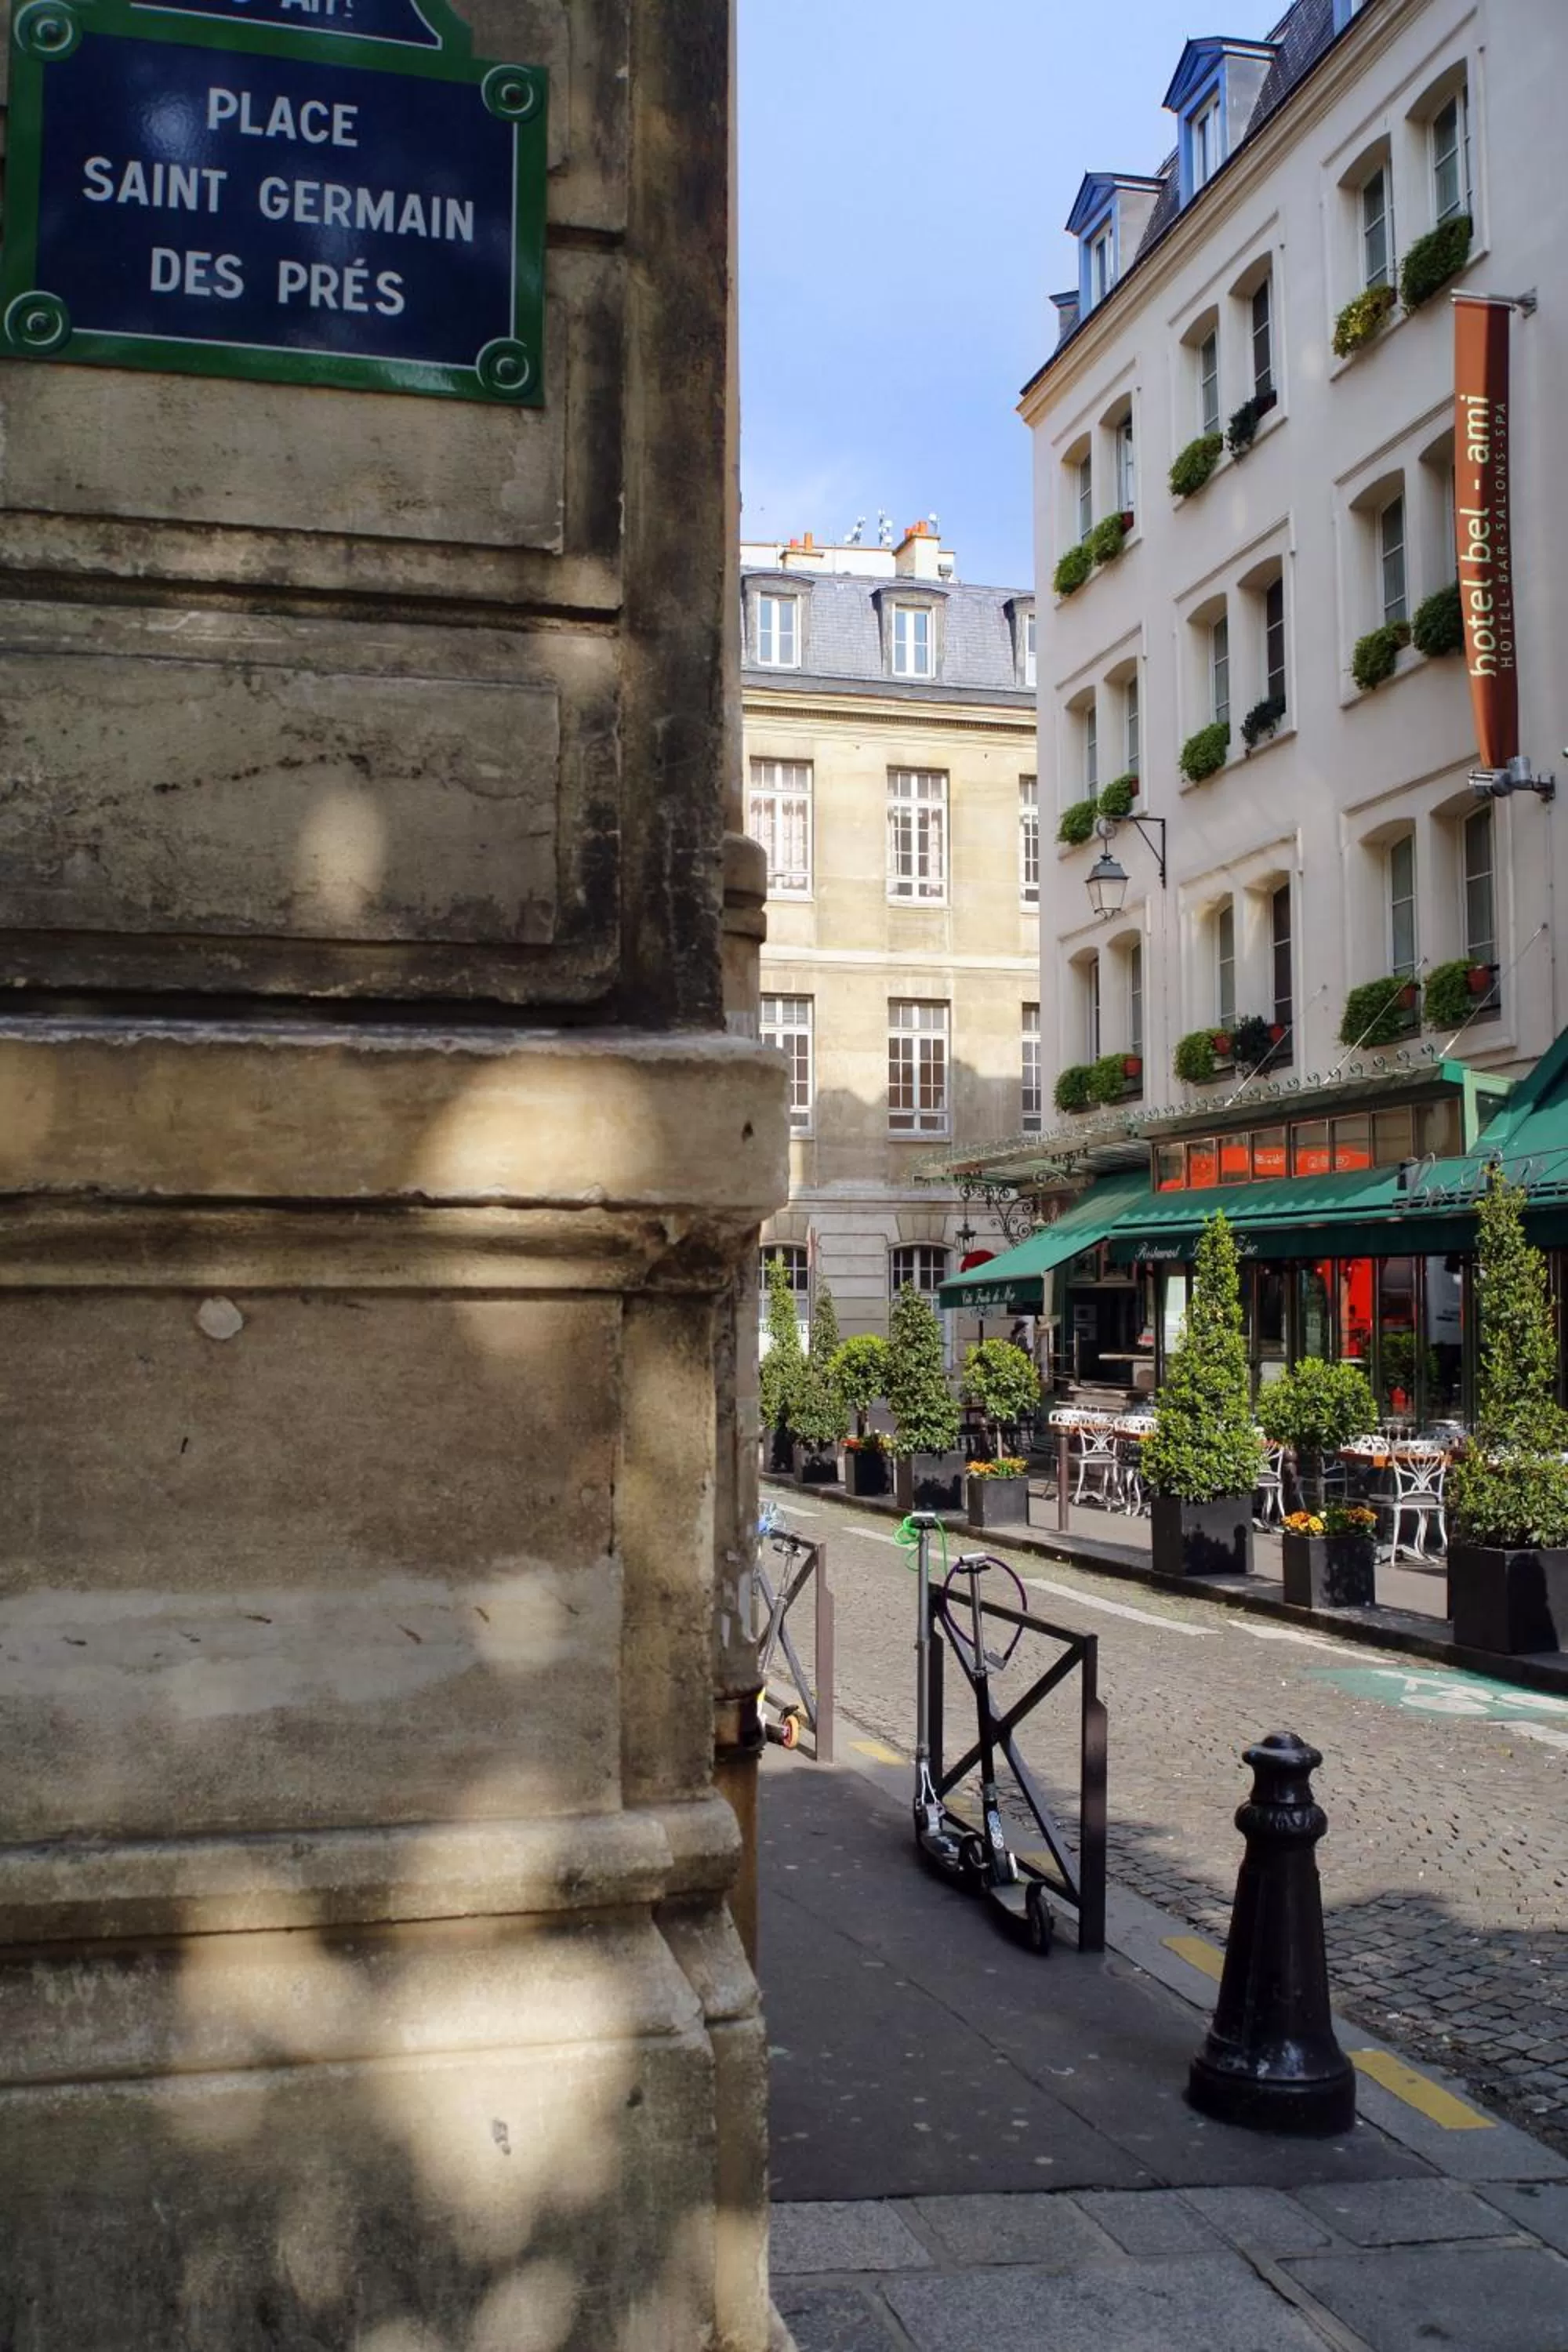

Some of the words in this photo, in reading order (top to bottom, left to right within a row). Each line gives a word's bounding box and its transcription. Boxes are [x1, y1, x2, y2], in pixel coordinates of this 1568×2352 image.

[208, 87, 358, 147] PLACE
[82, 156, 227, 212] SAINT
[260, 176, 474, 241] GERMAIN
[150, 247, 244, 299] DES
[278, 258, 405, 315] PRÉS
[1460, 394, 1490, 464] ami
[1459, 507, 1492, 563] bel
[1461, 578, 1497, 677] hotel
